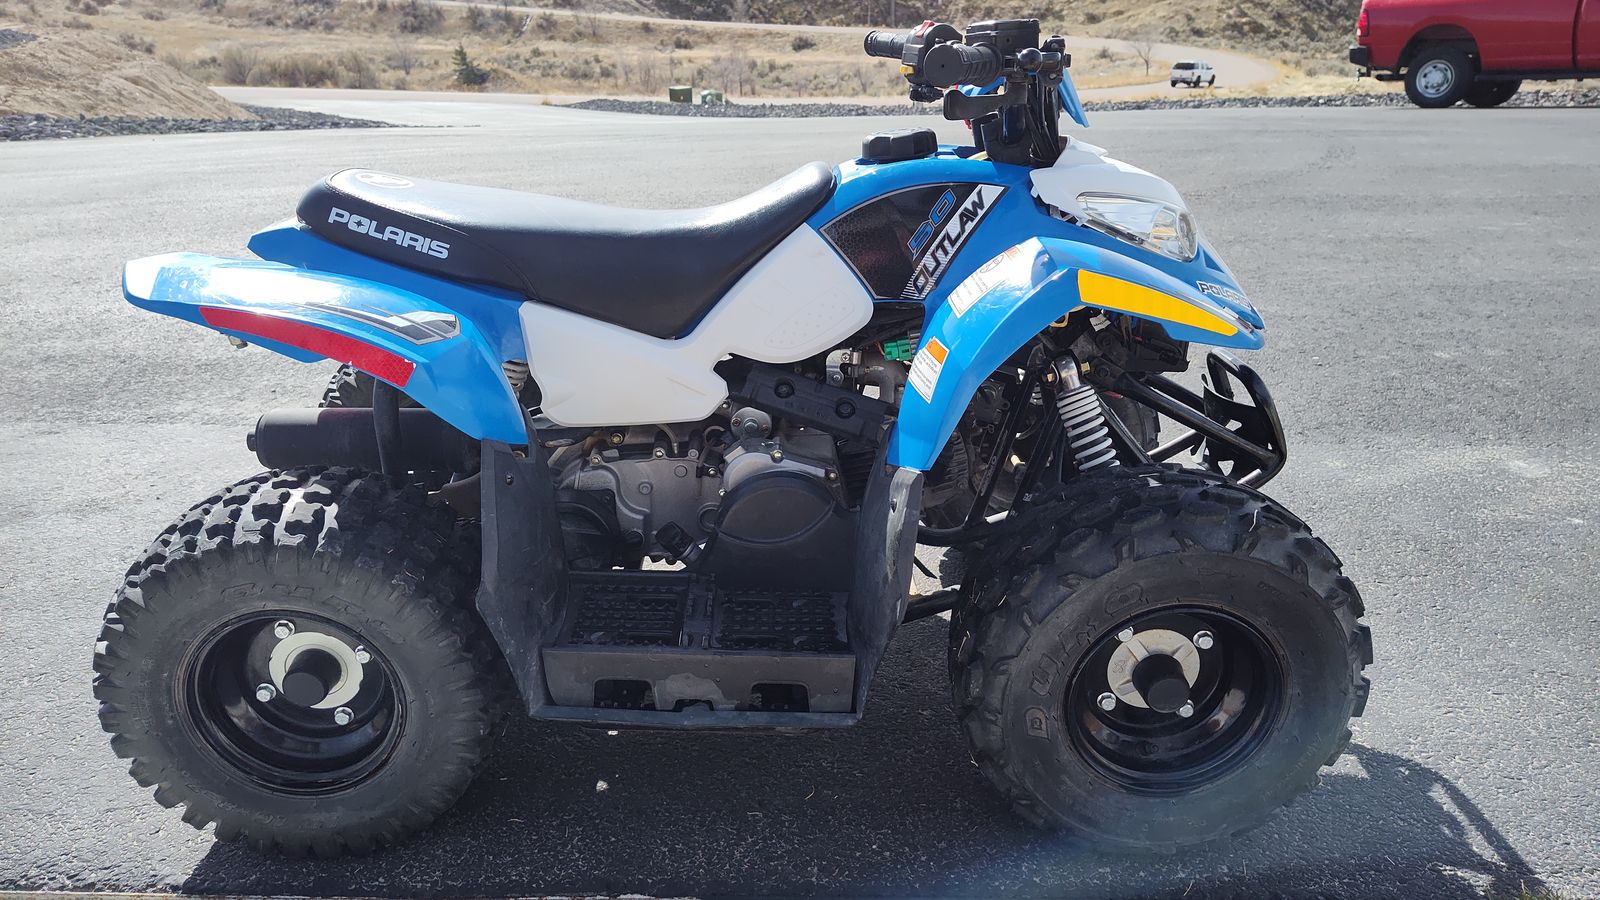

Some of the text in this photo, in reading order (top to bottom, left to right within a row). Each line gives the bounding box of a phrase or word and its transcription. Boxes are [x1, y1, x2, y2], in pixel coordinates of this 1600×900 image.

[328, 207, 450, 259] POLARIS
[907, 188, 957, 261] 50
[912, 186, 985, 296] OUTLAW
